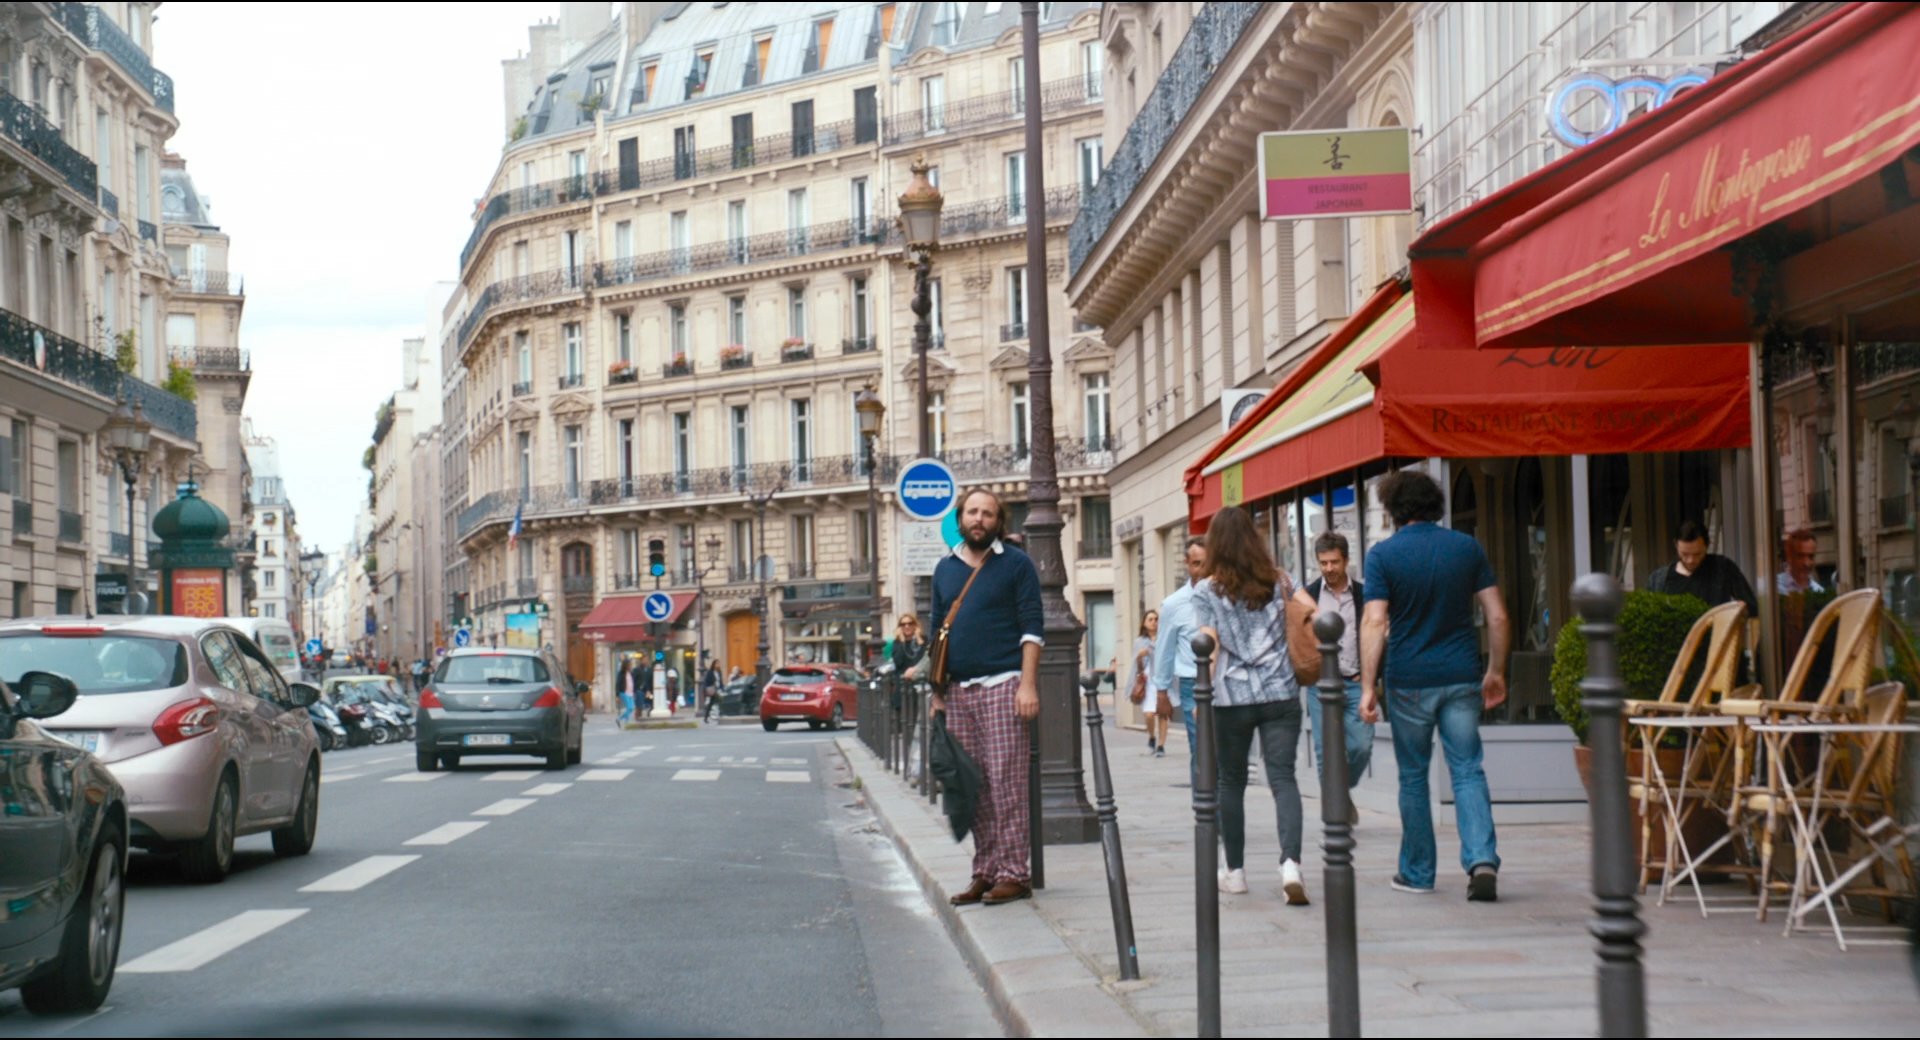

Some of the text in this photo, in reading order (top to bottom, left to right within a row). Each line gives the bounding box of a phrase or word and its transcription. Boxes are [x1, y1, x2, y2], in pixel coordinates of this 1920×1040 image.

[1308, 182, 1368, 194] RESTAURANT
[1315, 198, 1364, 209] JAPONAIS
[1639, 172, 1671, 249] Le
[1431, 407, 1581, 433] RESTAURANT
